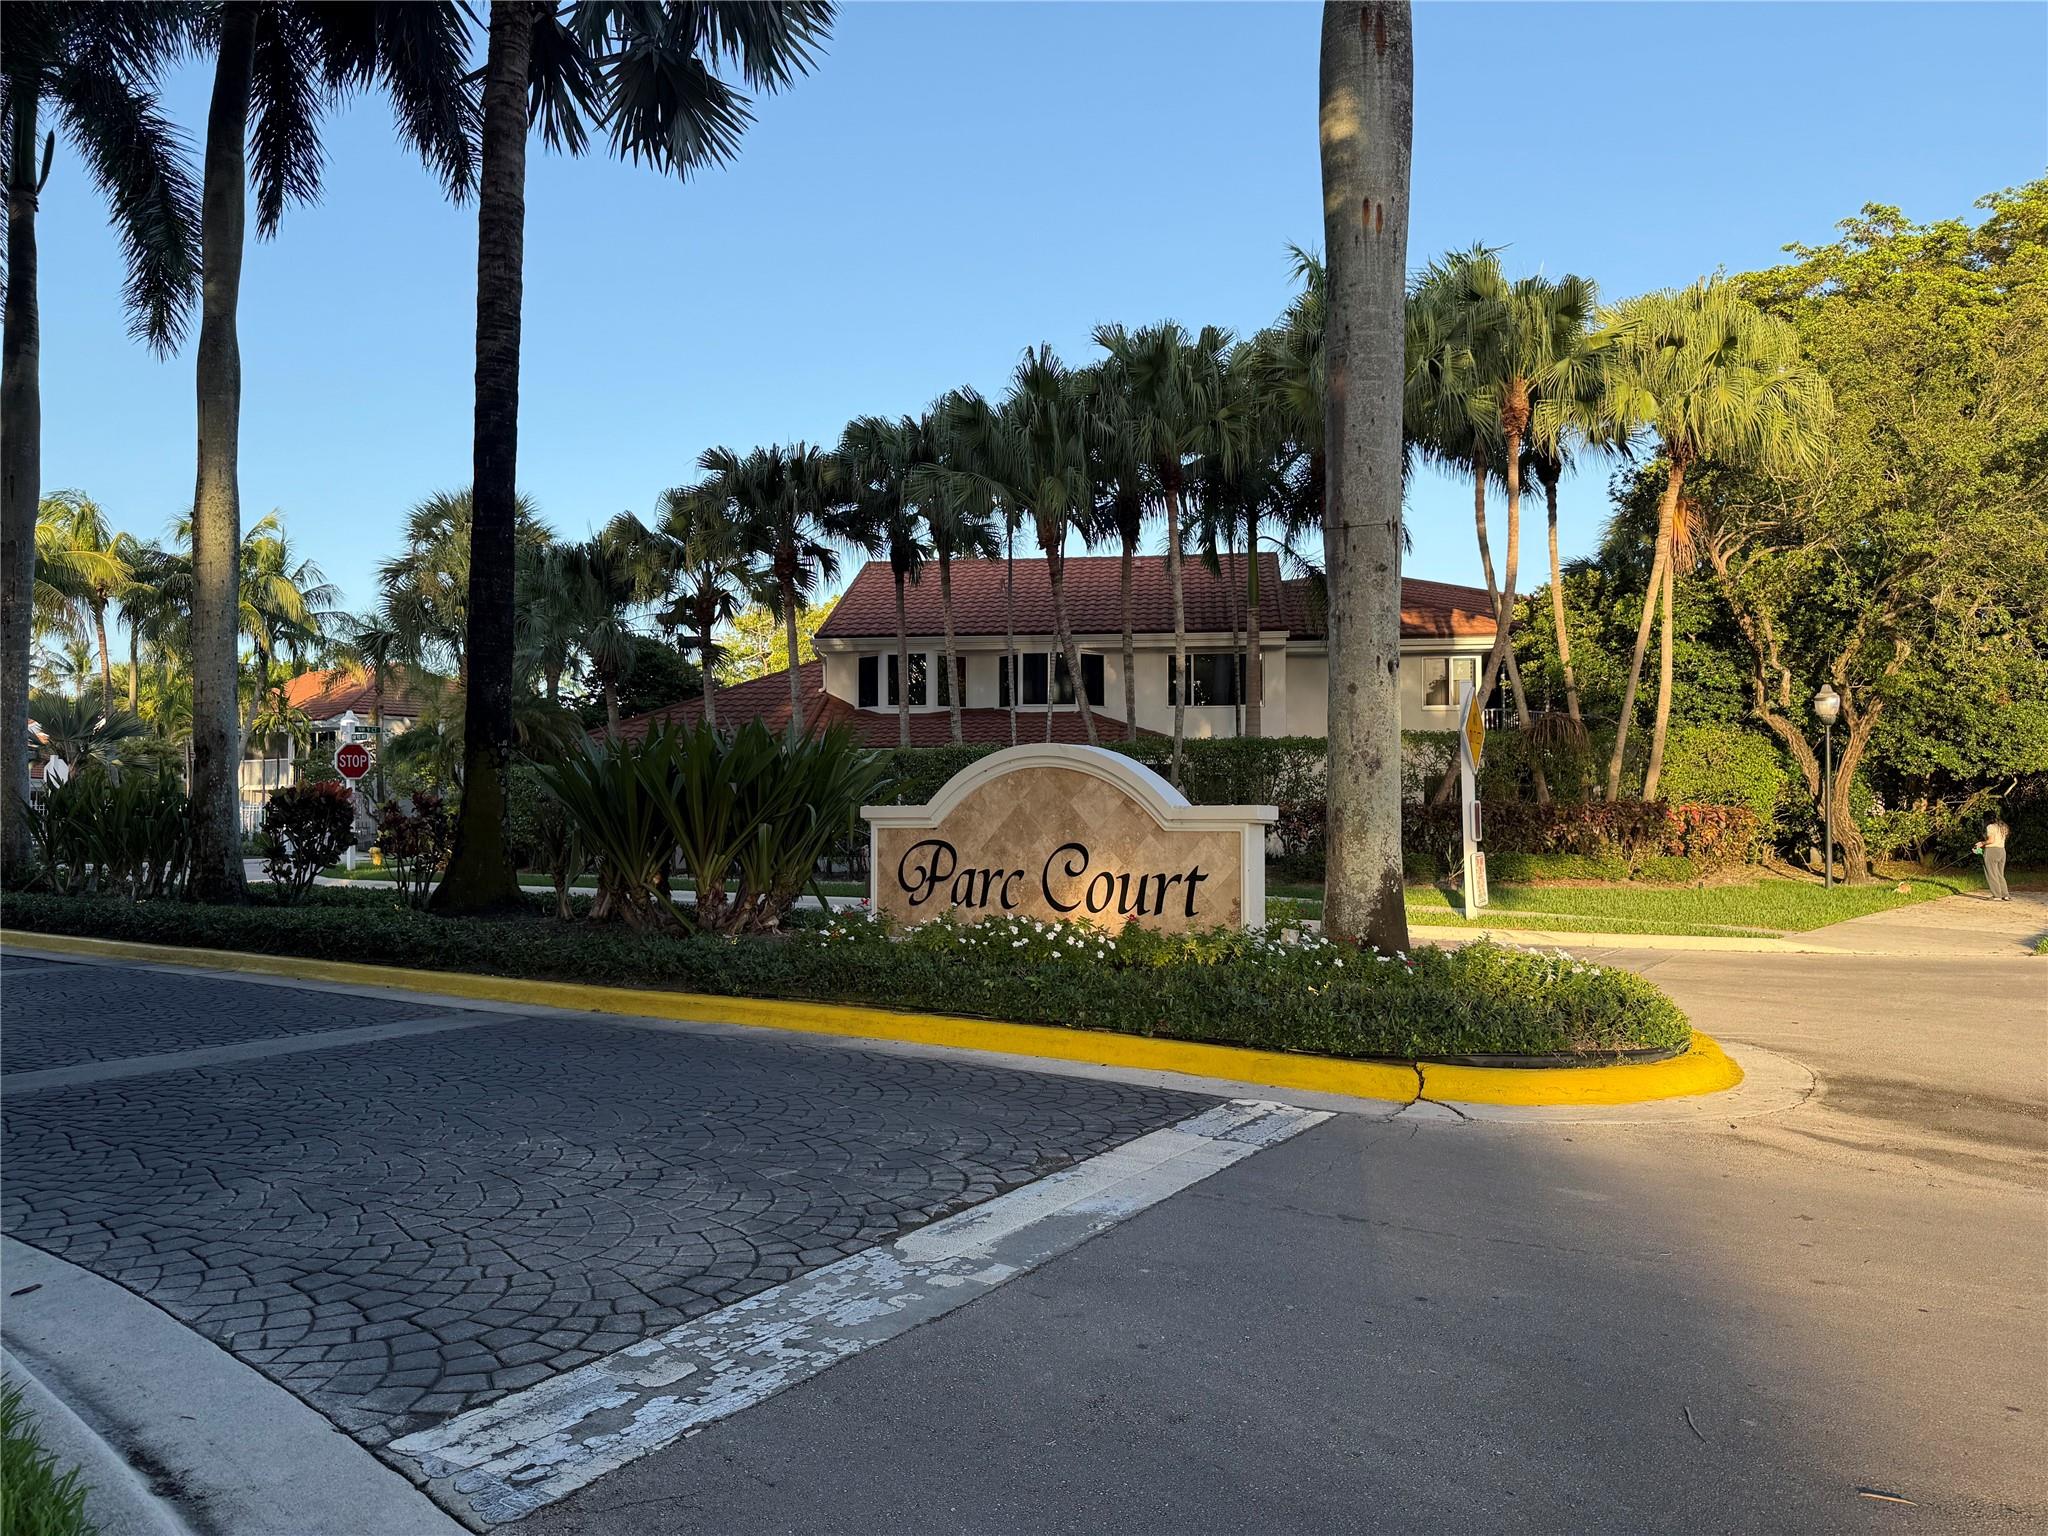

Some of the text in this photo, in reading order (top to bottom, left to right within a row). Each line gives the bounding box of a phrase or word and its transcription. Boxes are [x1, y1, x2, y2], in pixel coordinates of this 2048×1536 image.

[339, 754, 367, 768] STOP
[897, 839, 1208, 917] Parc Court
